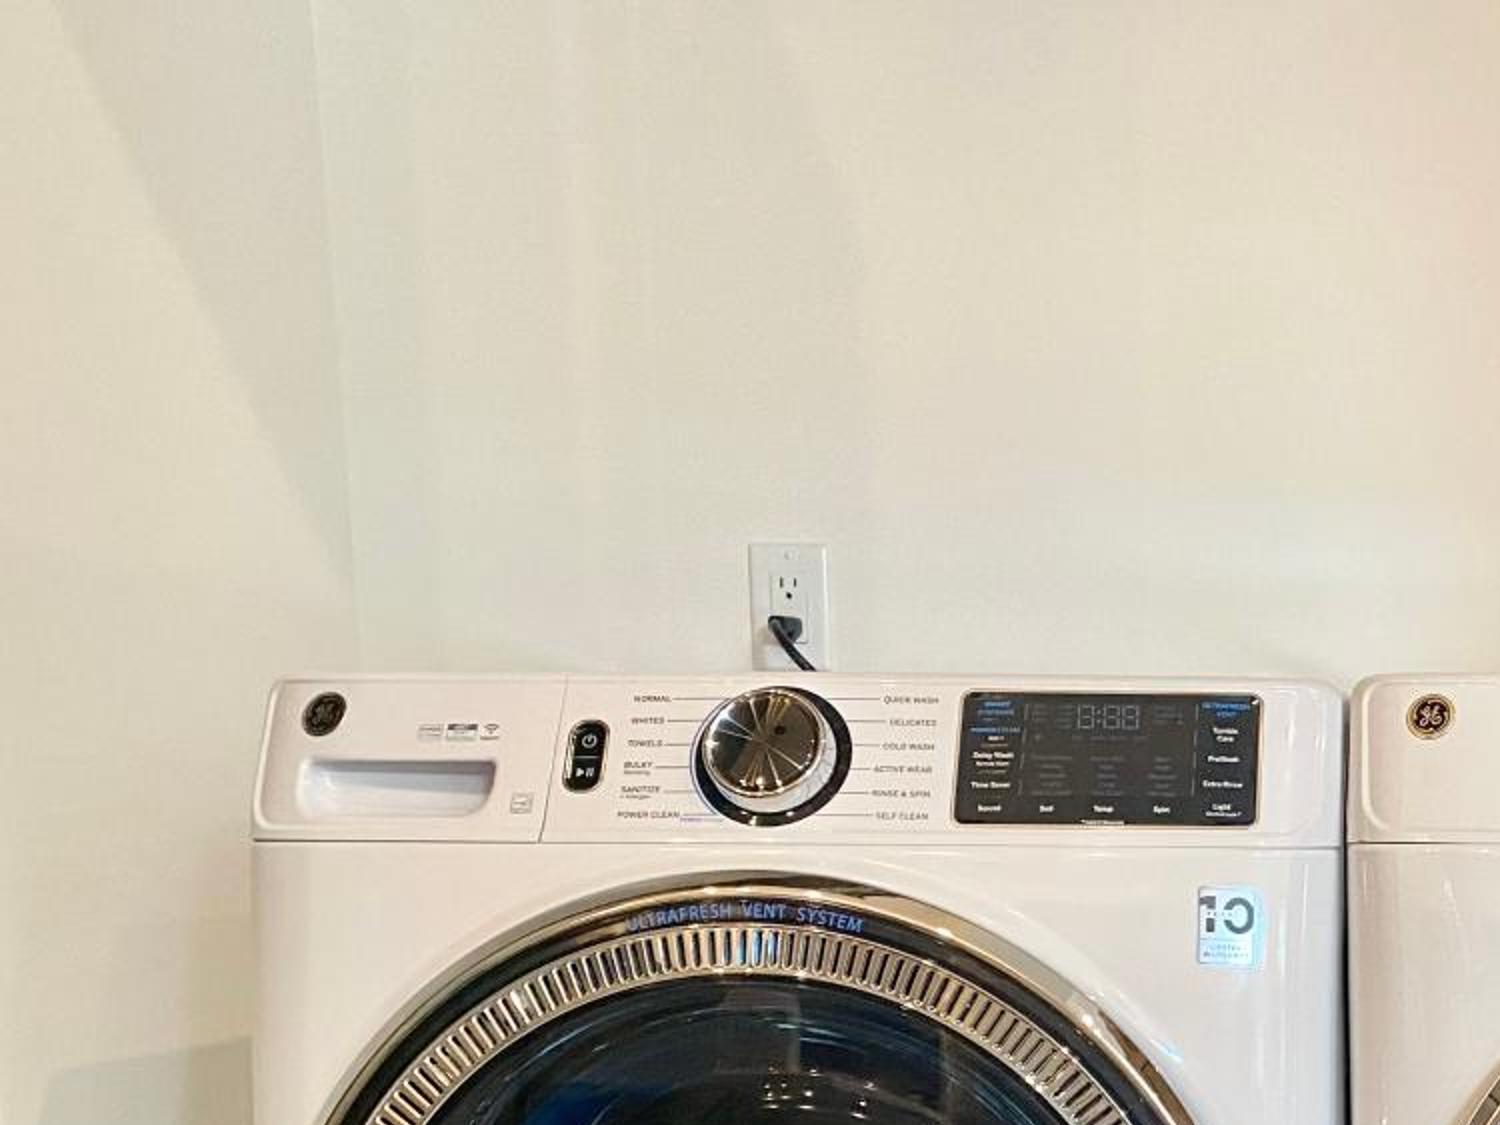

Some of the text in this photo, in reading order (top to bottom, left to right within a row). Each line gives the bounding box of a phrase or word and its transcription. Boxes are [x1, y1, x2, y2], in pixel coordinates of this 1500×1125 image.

[633, 695, 672, 703] NORMAL
[884, 695, 940, 705] QUICK WASH
[631, 717, 665, 725] WHITES
[628, 740, 664, 748] TOWELS
[882, 742, 936, 751] COLD WASH
[624, 761, 654, 769] BULKY
[617, 811, 681, 819] POWER CLEAN
[899, 812, 929, 820] CLEAN
[625, 900, 865, 934] ULTRAFRESH VENT SYSTEM
[1199, 895, 1255, 934] 10
